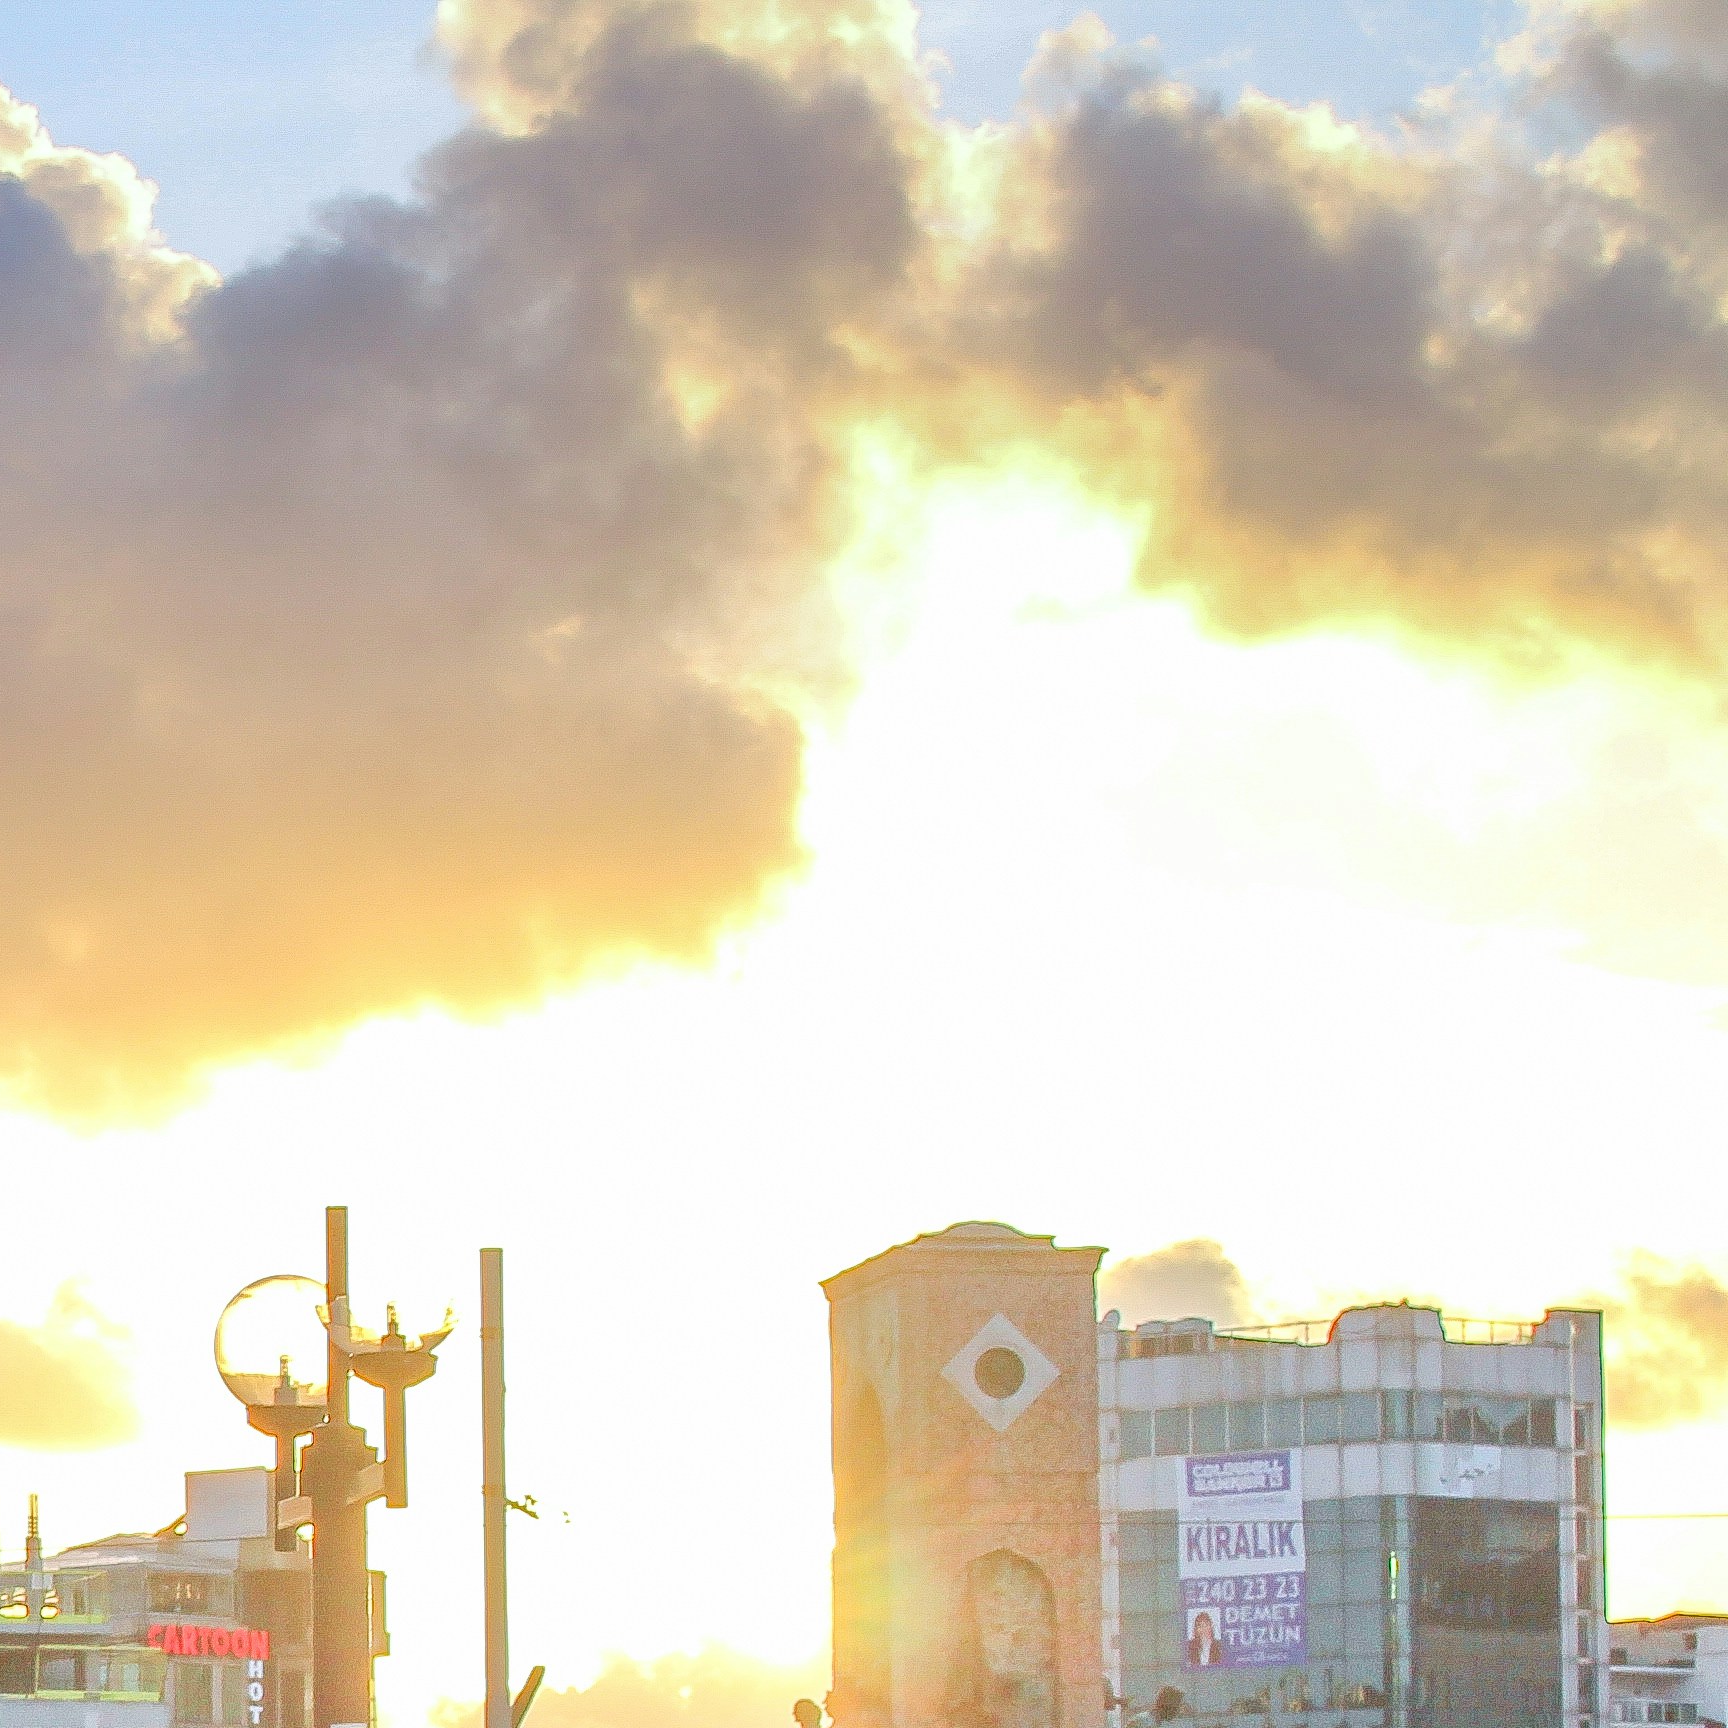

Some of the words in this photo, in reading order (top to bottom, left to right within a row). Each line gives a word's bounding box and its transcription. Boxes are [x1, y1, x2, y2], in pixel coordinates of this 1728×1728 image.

[1197, 1578, 1236, 1603] 240
[1243, 1576, 1267, 1601] 23
[1276, 1574, 1301, 1599] 23
[1224, 1602, 1301, 1624] DEMET
[147, 1624, 270, 1661] CARTOON
